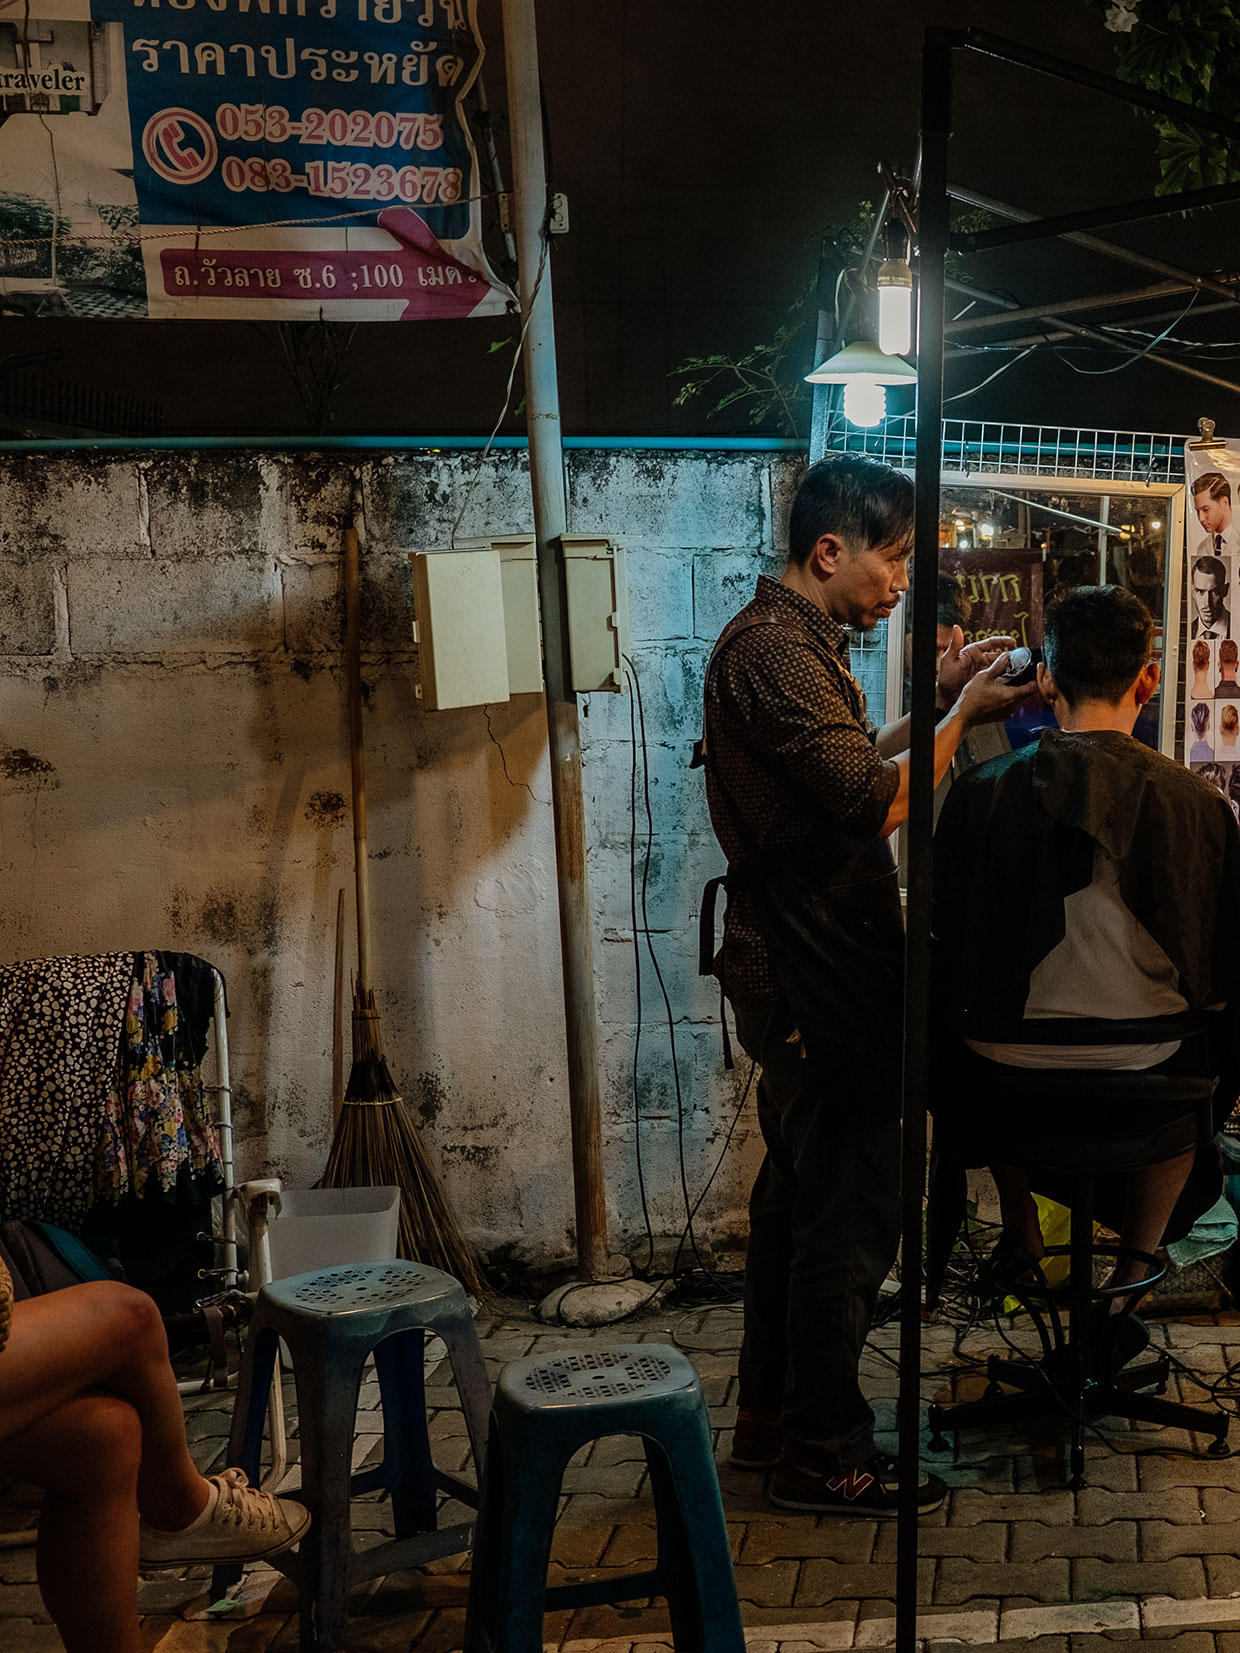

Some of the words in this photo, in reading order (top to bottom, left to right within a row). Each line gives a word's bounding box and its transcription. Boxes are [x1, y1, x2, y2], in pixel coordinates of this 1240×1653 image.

[132, 38, 464, 87] ราคาประหยัด
[216, 103, 443, 150] 053-202075
[222, 156, 463, 202] 083-1523678
[174, 257, 282, 288] ถ.วัวลาย
[293, 264, 337, 289] ซ.6
[417, 265, 477, 287] เมต
